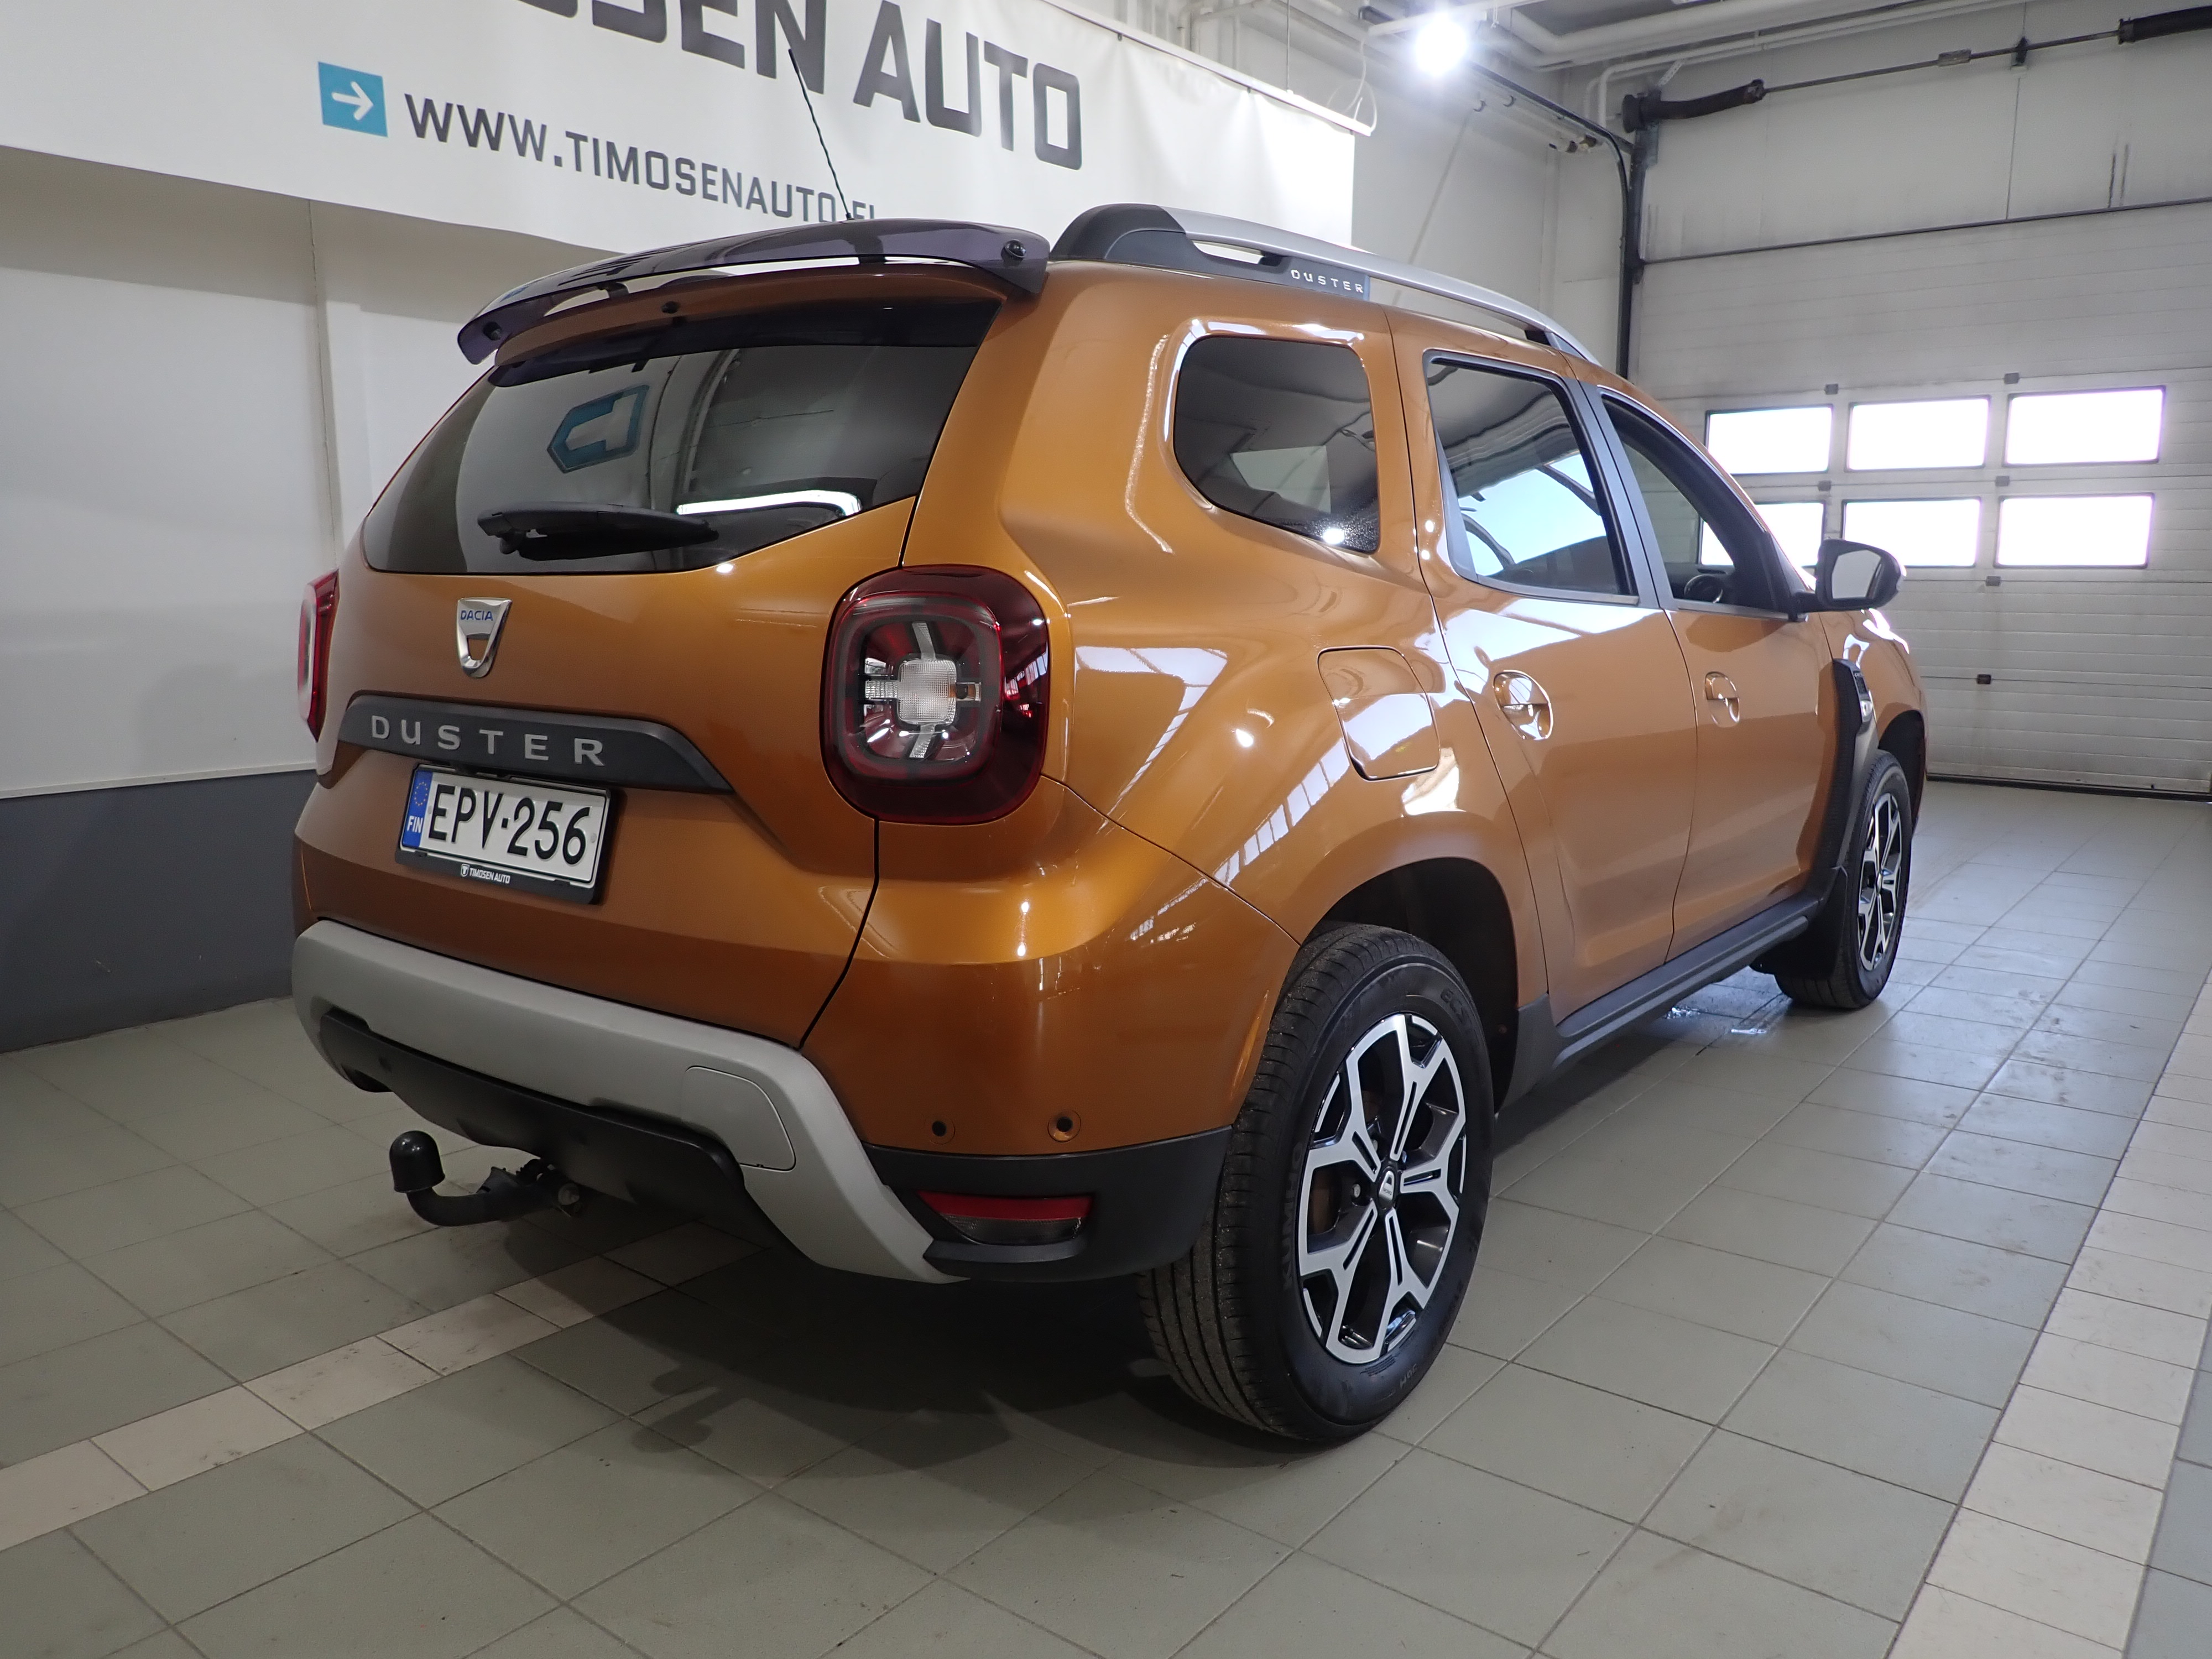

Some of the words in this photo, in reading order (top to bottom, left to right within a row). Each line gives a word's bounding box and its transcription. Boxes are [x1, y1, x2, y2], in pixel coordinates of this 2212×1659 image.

[853, 0, 1082, 171] AUTO
[1291, 269, 1364, 293] DUSTER
[460, 610, 493, 621] DACIA
[371, 716, 604, 766] DUSTER
[407, 816, 423, 833] FIN
[469, 868, 494, 880] TIMOSEN
[494, 873, 510, 884] AUTO
